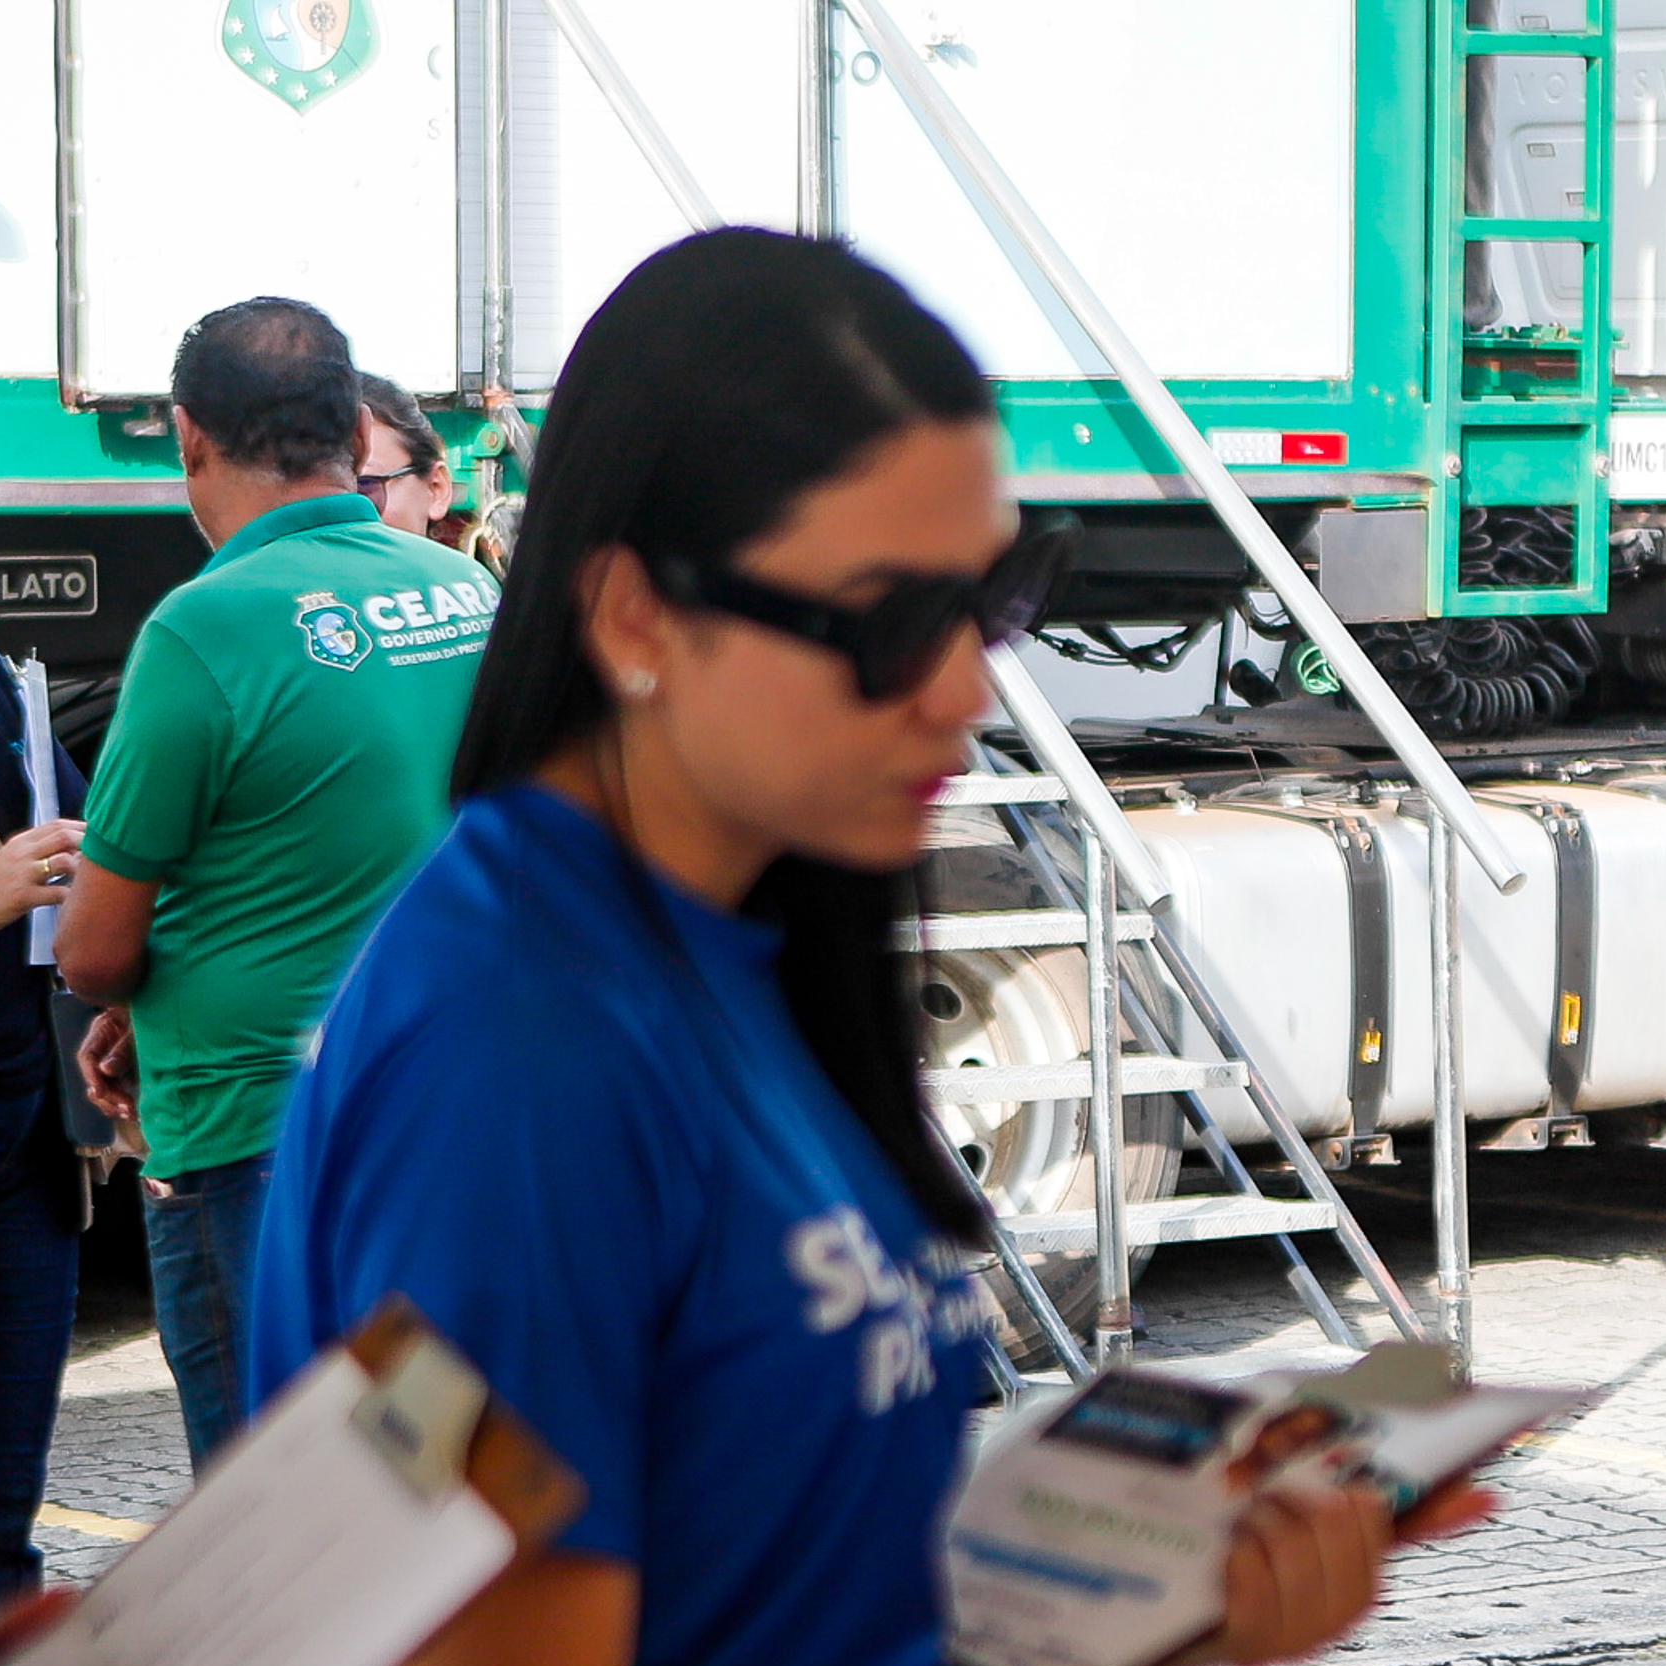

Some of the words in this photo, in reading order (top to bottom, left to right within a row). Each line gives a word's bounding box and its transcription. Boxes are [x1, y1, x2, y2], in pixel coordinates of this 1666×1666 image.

[364, 571, 501, 631] CEARÁ
[380, 624, 459, 649] GOVERNO
[460, 620, 482, 636] DO
[389, 649, 443, 666] SECRETARIA
[444, 647, 458, 659] DA
